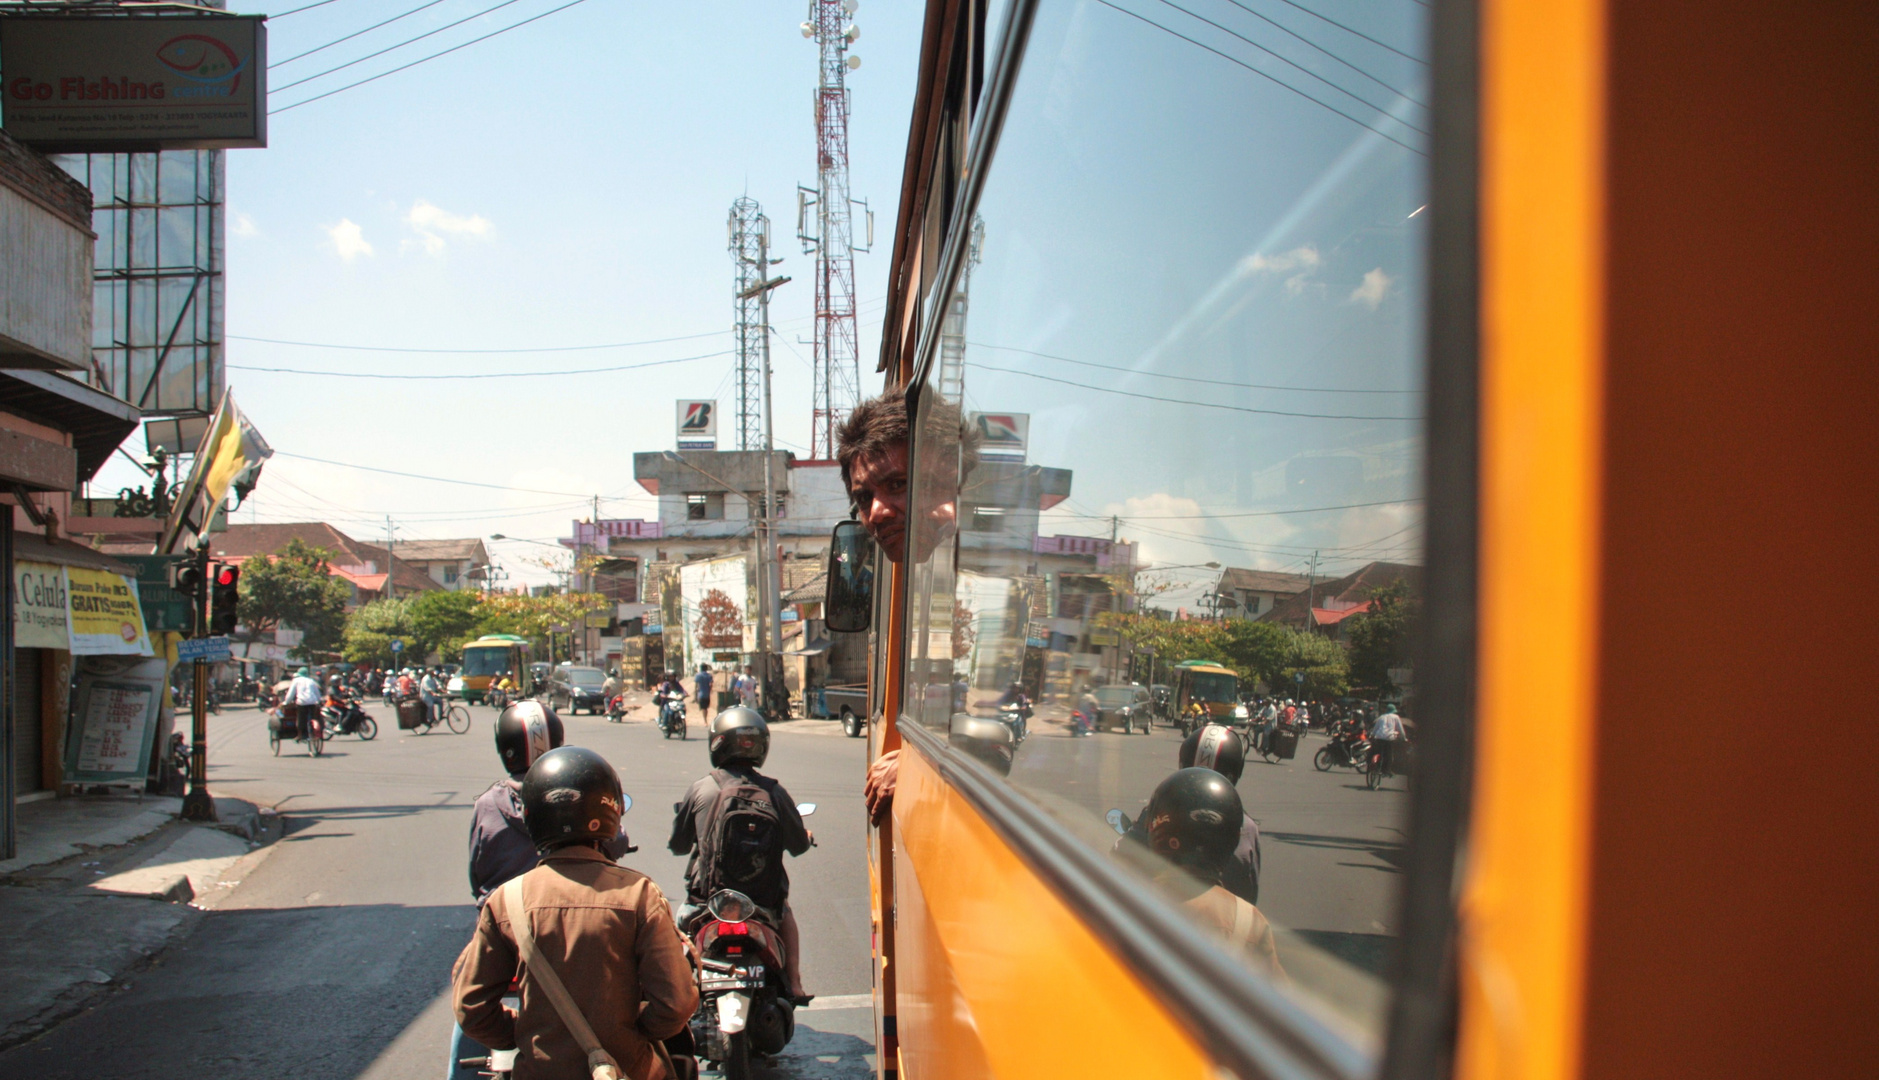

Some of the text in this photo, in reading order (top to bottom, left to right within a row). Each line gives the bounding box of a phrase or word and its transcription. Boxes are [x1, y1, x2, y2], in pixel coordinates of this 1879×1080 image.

[9, 76, 165, 100] Go Fishing
[172, 85, 231, 98] centre
[196, 111, 248, 119] YOGYAKARTA
[22, 573, 66, 609] Celula
[71, 595, 111, 613] GRATIS
[748, 965, 765, 978] VP
